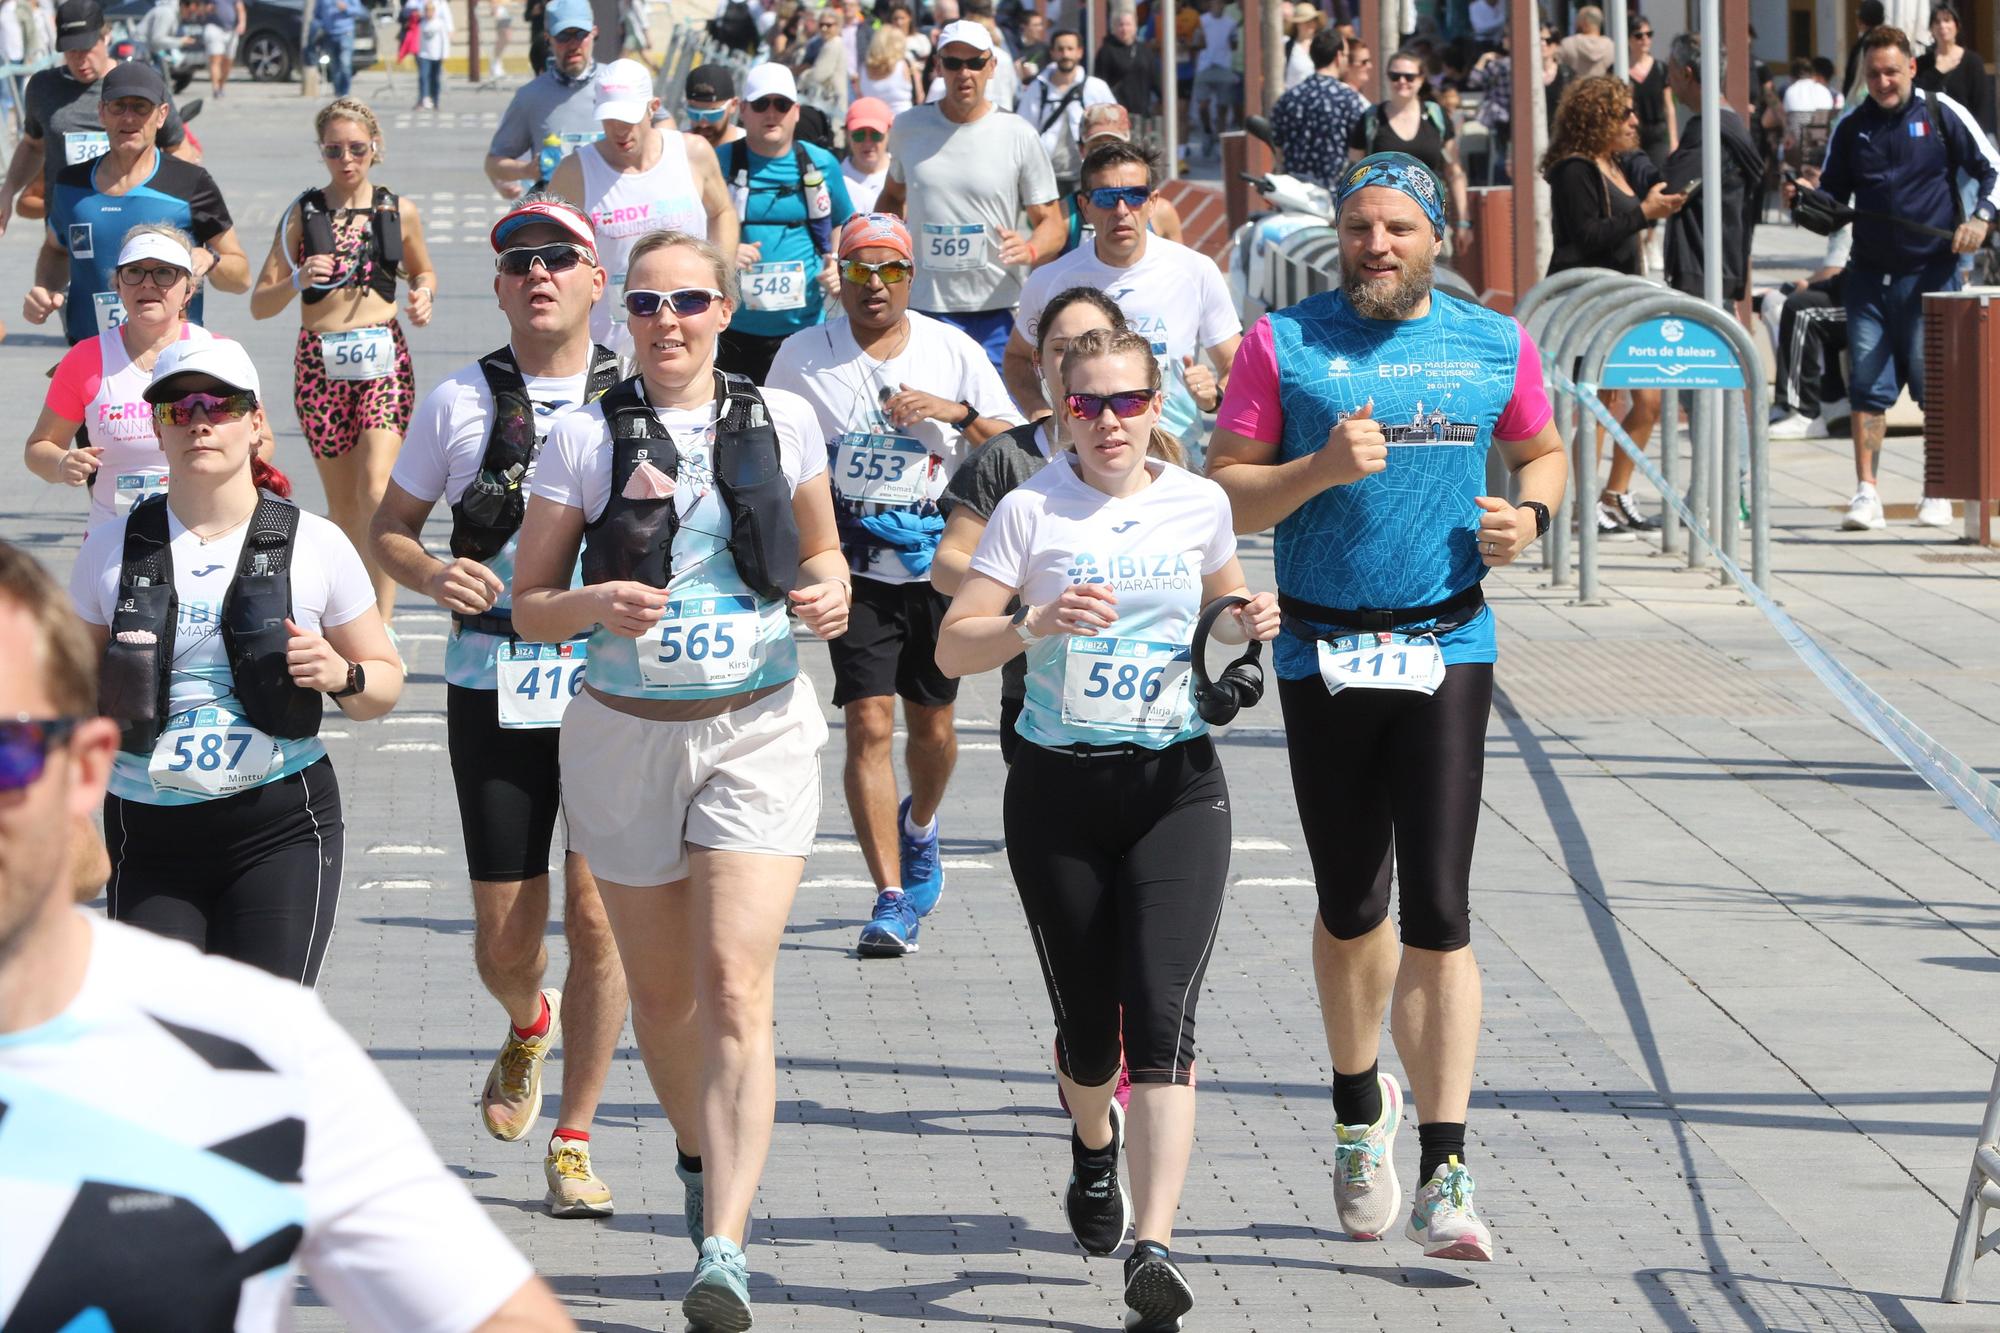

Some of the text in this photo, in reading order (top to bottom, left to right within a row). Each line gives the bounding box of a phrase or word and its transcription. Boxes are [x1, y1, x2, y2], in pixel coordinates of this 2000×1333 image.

[931, 238, 970, 256] 569
[752, 276, 791, 297] 548
[335, 342, 377, 365] 564
[1628, 345, 1717, 358] Ports de Balears
[1378, 361, 1480, 378] EDP MARATONA
[1441, 369, 1475, 377] LISBOA
[847, 452, 906, 481] 553
[883, 484, 912, 493] Thomas
[1109, 554, 1190, 579] IBIZA
[1109, 577, 1192, 592] MARATHON
[658, 621, 735, 663] 565
[728, 659, 750, 670] Kirsi
[516, 664, 587, 700] 416
[1083, 661, 1165, 703] 586
[1147, 705, 1171, 717] Mirja
[168, 733, 253, 772] 587
[228, 773, 264, 783] Minttu
